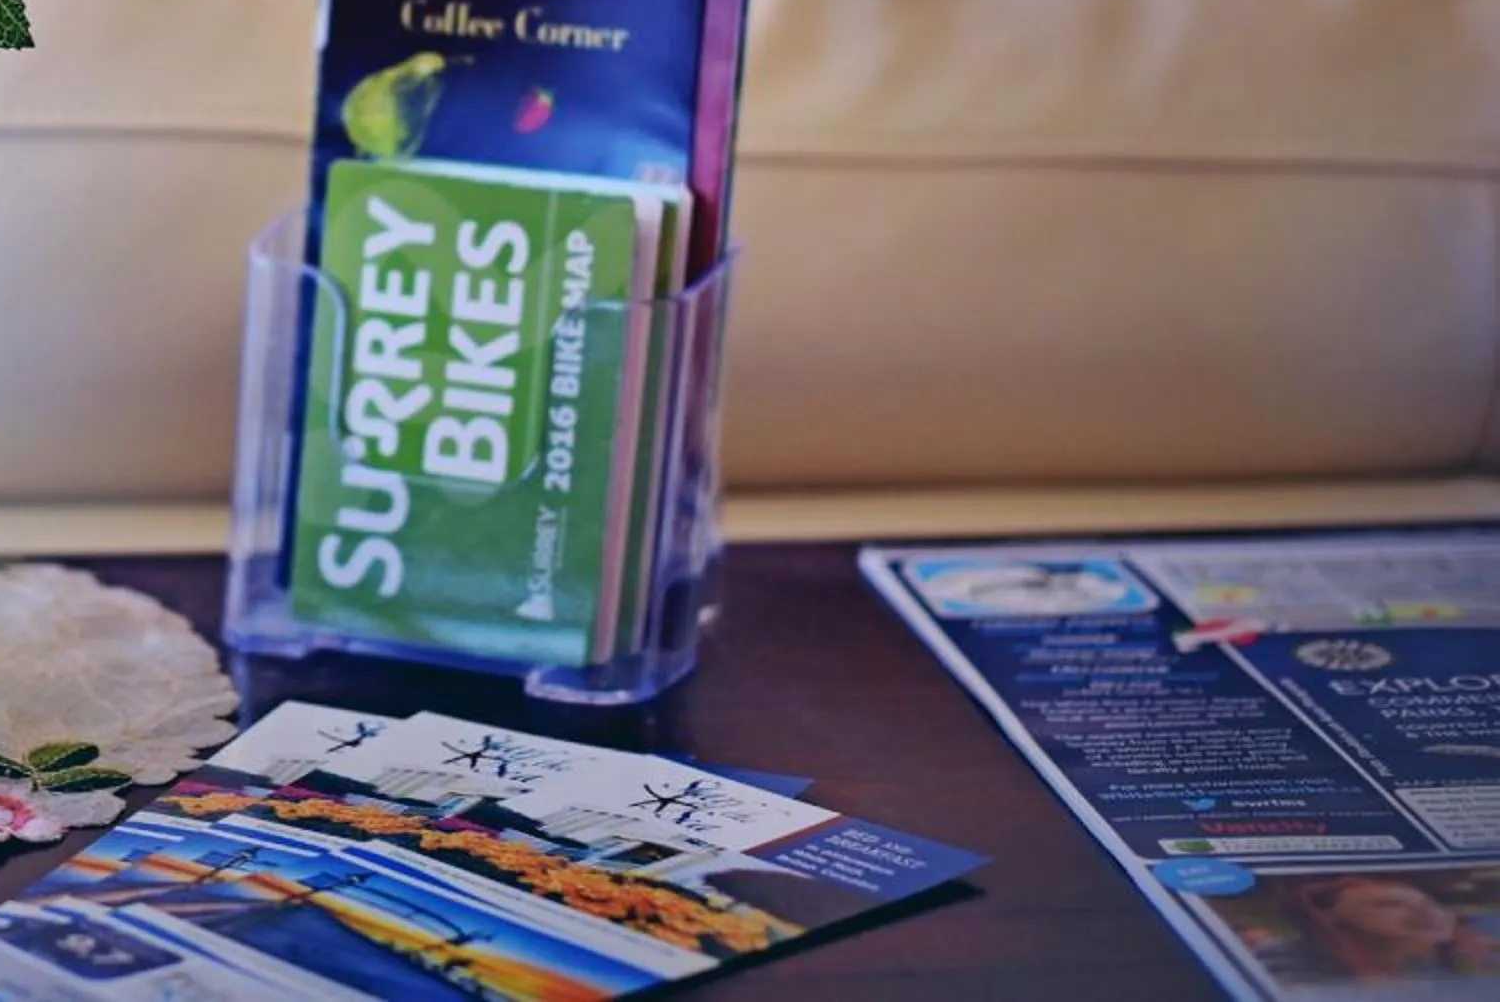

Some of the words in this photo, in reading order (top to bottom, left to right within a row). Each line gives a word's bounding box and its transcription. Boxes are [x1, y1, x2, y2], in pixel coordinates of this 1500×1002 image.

[400, 1, 505, 39] Coffee
[514, 6, 629, 51] Corner
[561, 229, 595, 311] MAP
[422, 219, 530, 484] BIKES
[550, 319, 586, 398] BIKE
[544, 404, 578, 493] 2016
